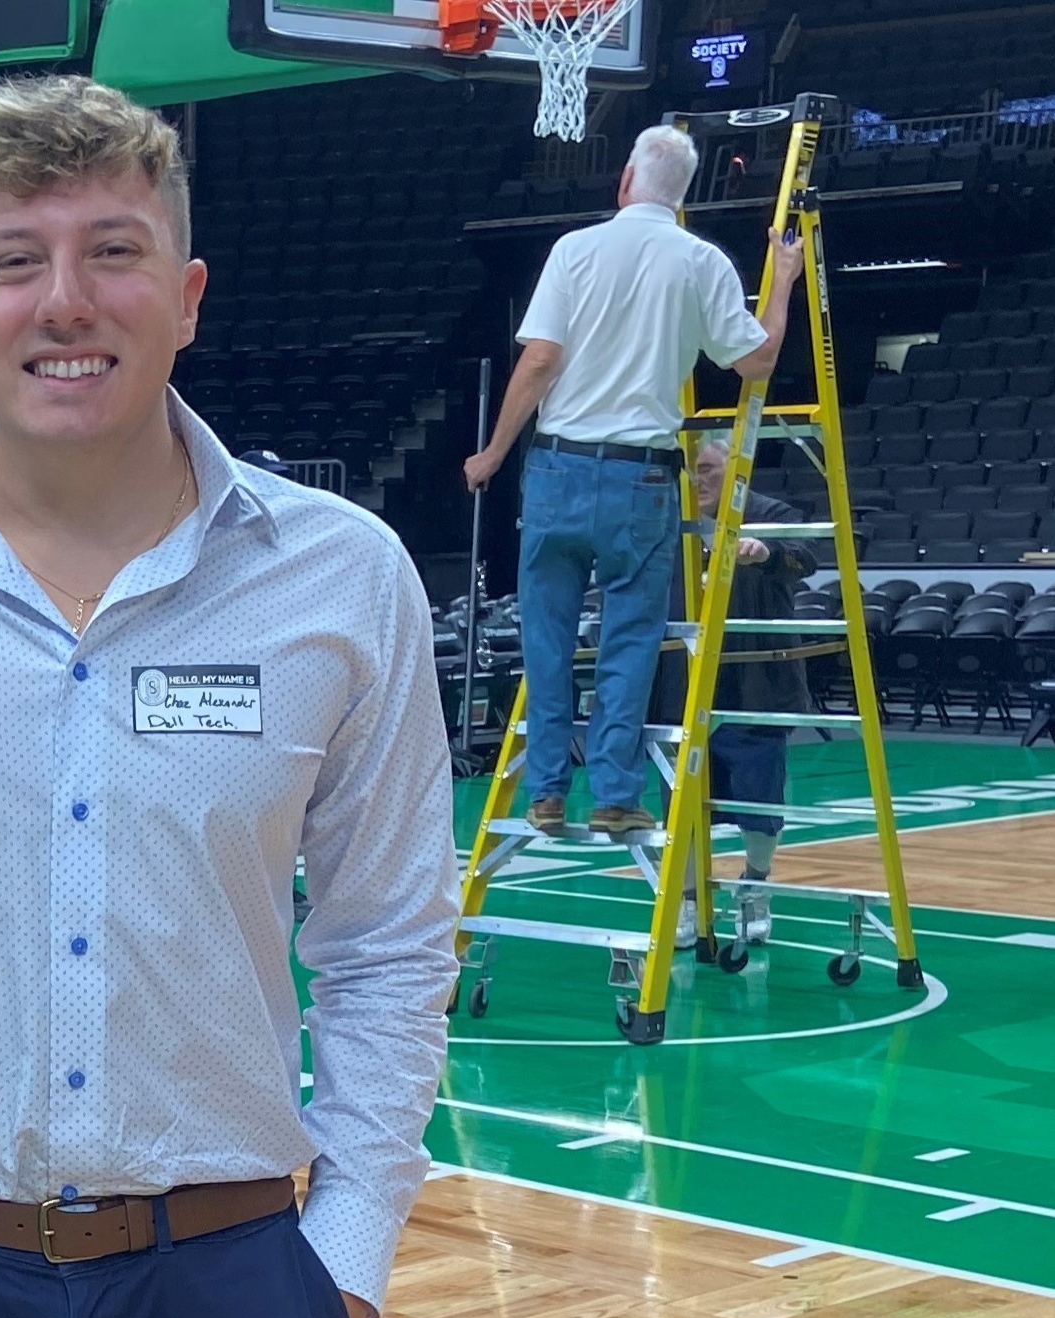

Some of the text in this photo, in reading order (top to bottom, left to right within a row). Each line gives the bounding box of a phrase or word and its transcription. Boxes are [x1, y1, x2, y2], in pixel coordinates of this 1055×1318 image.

[691, 40, 747, 58] SOCIETY
[202, 675, 217, 684] MY
[218, 675, 244, 684] NAME
[245, 675, 255, 684] IS
